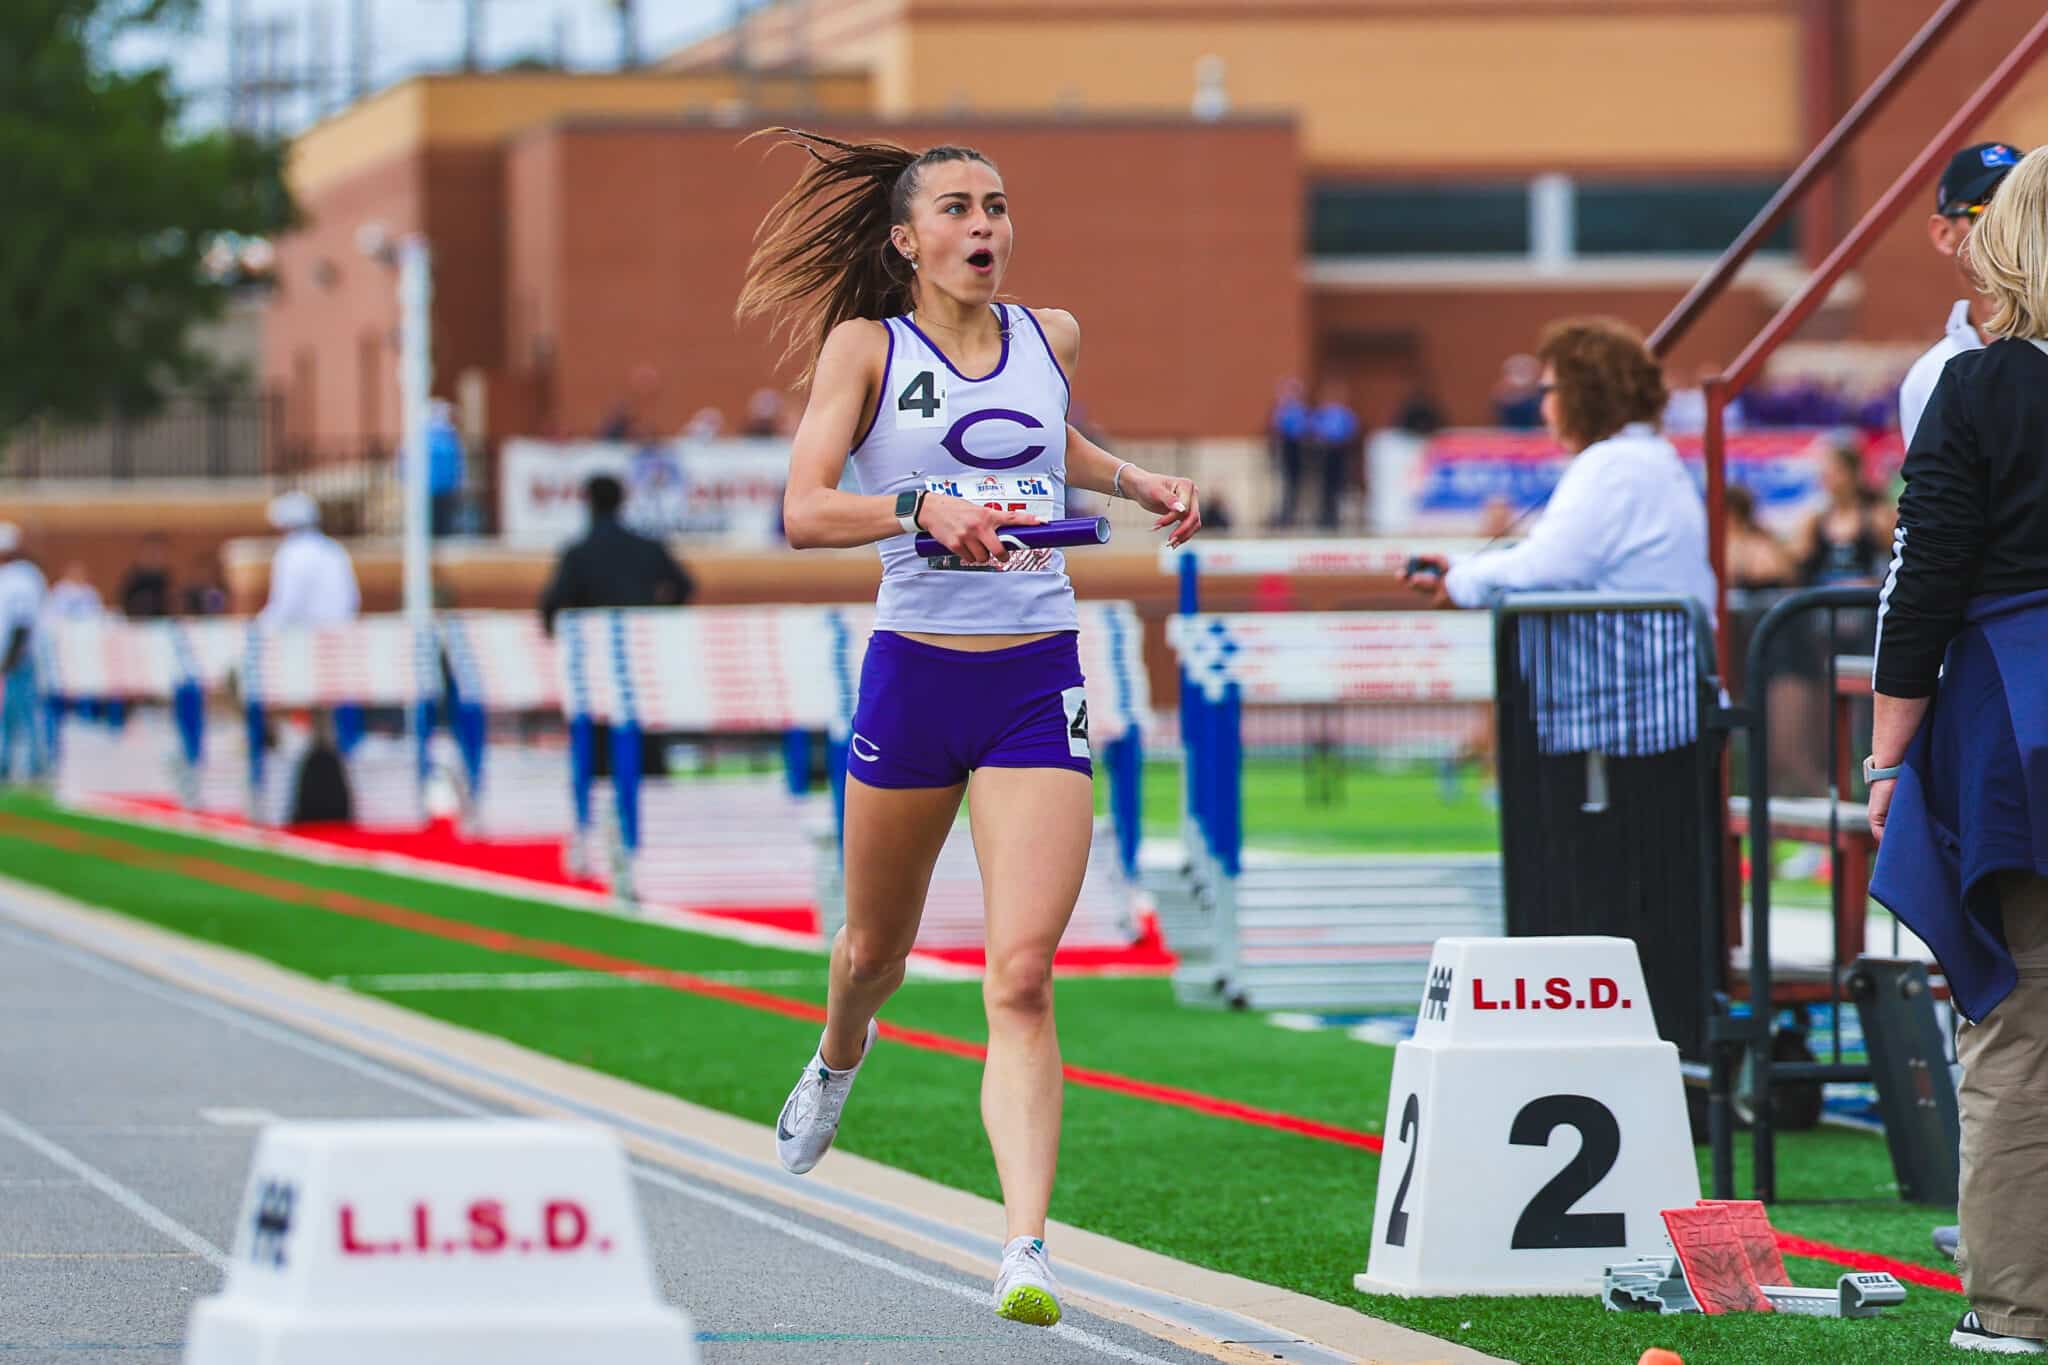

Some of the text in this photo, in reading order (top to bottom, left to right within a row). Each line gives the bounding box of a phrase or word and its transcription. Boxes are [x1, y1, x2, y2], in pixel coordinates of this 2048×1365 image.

[898, 371, 941, 419] 4
[940, 408, 1047, 470] C
[1472, 977, 1632, 1010] L.I.S.D.
[1385, 1093, 1420, 1247] 2
[1509, 1094, 1626, 1249] 2
[337, 1199, 614, 1256] L.I.S.D.
[1857, 1275, 1894, 1284] GILL
